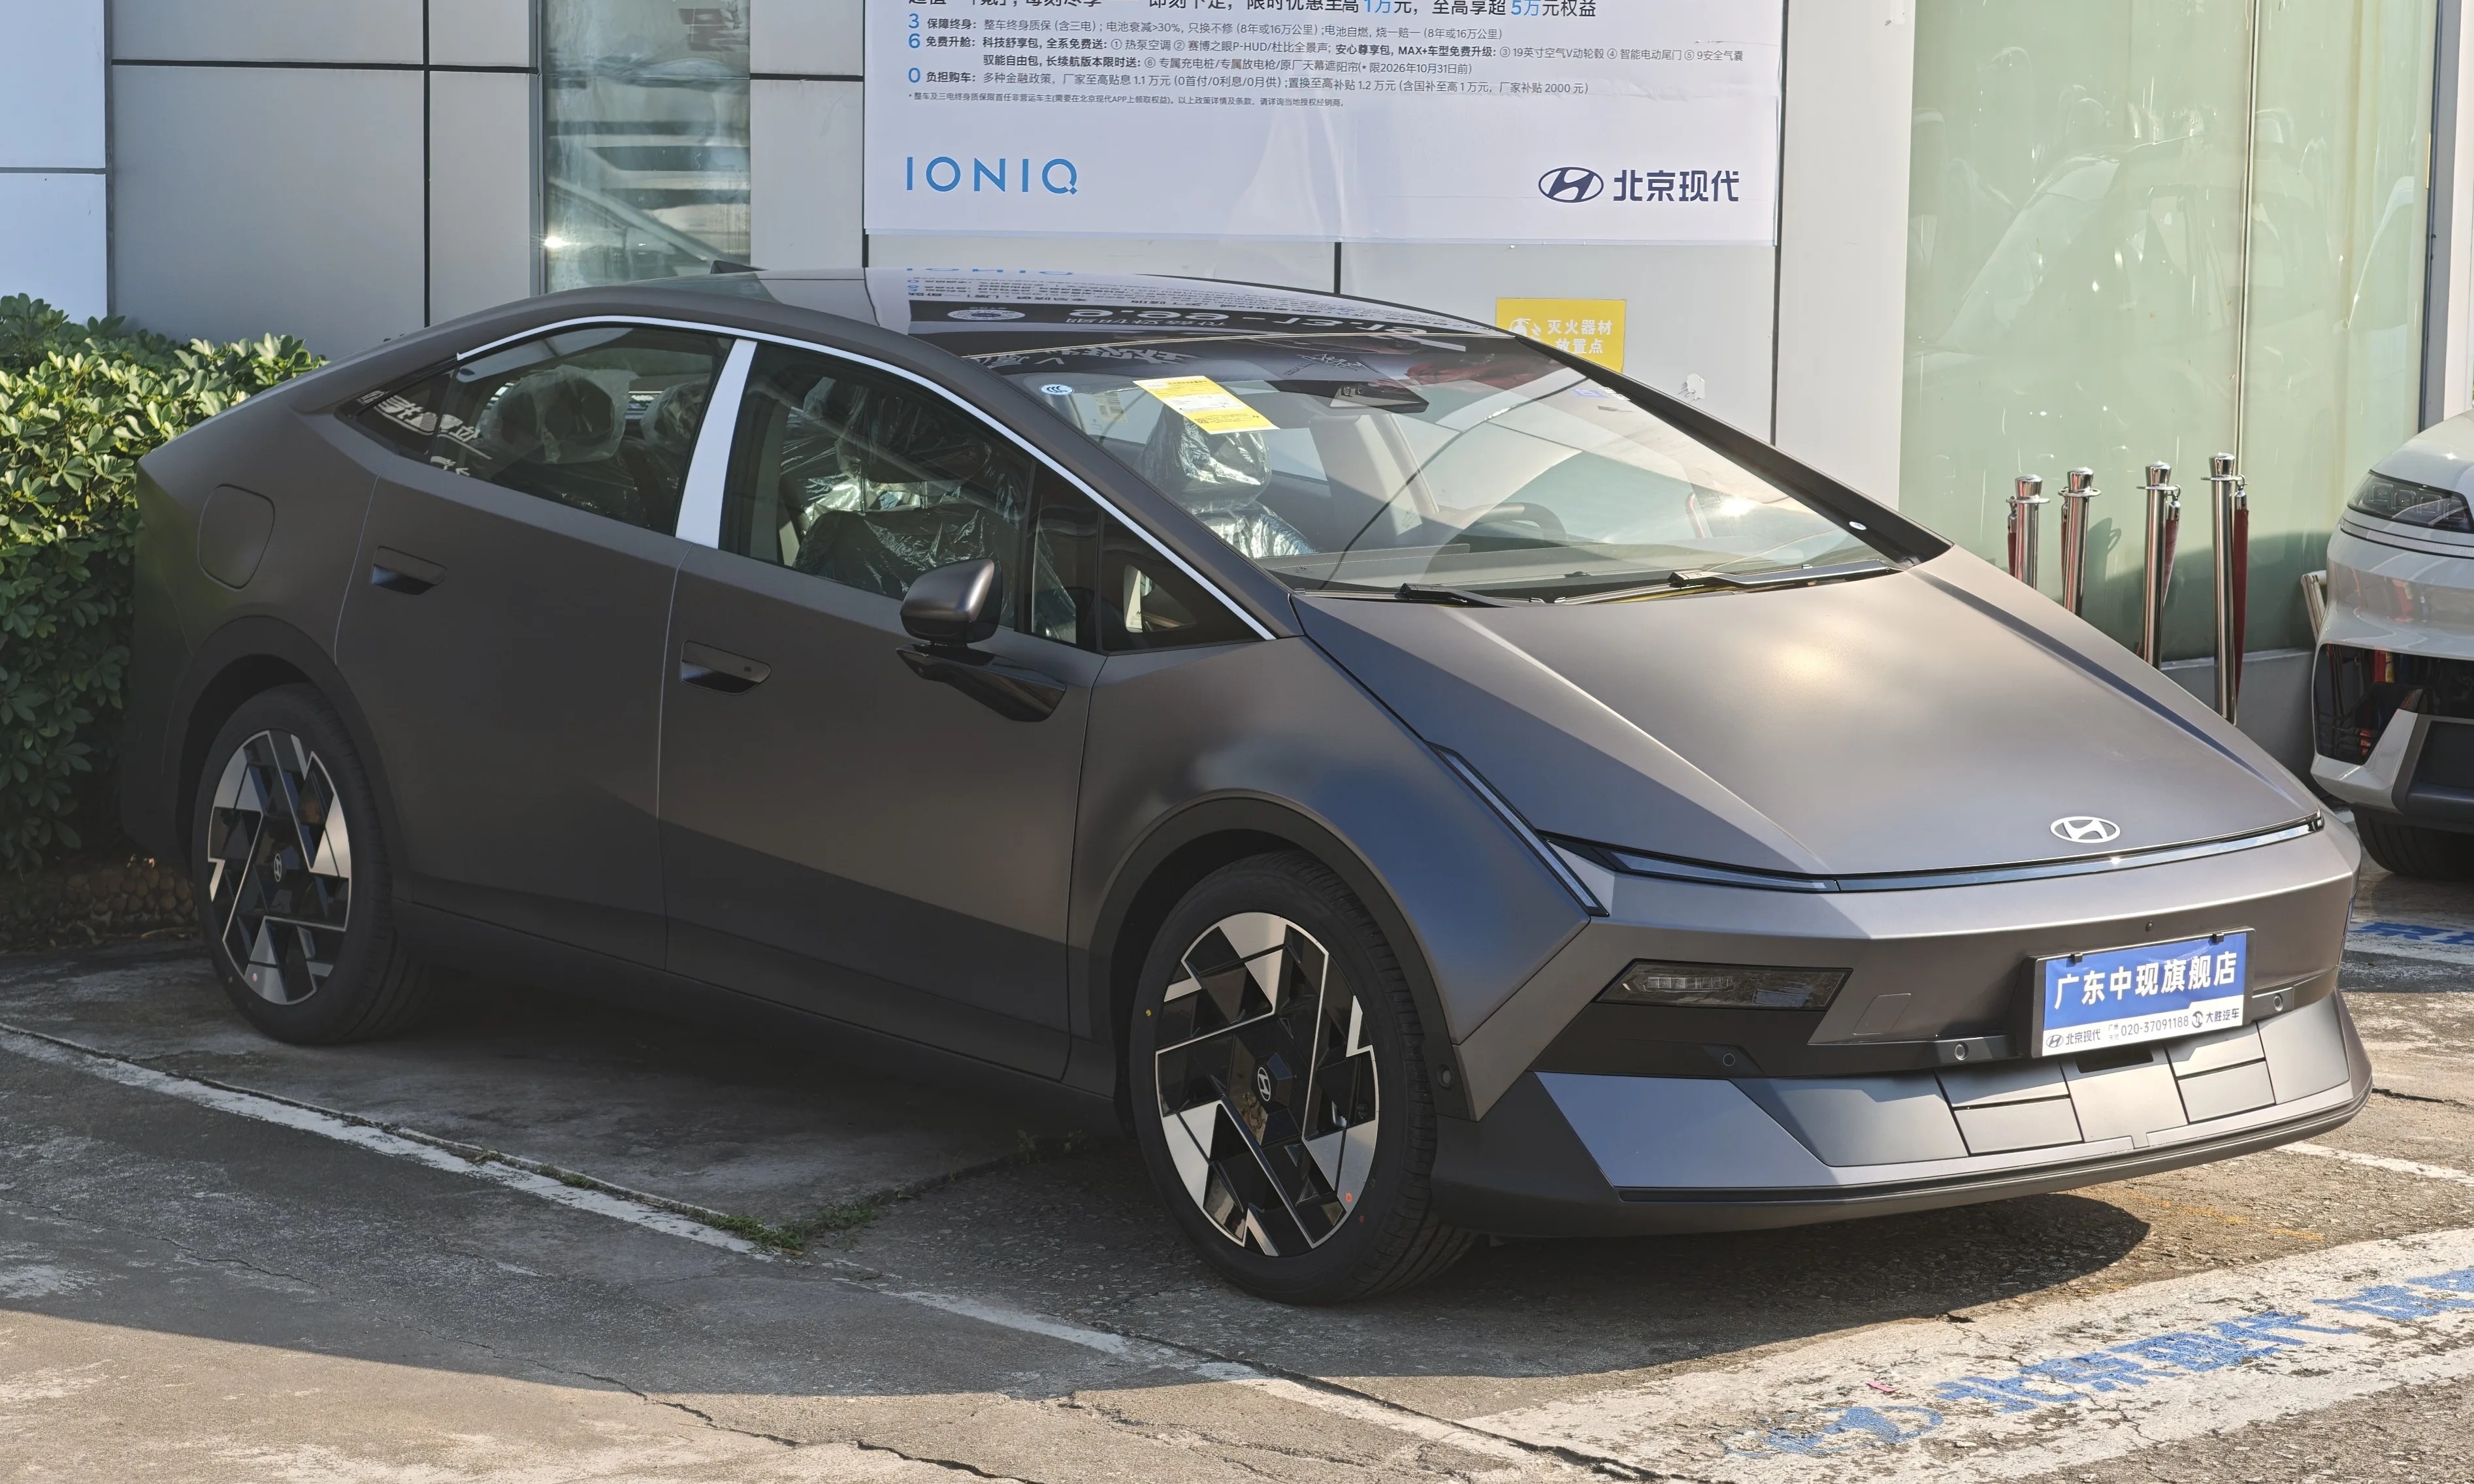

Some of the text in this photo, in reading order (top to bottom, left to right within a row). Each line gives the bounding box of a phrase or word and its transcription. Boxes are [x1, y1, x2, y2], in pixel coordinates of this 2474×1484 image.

[909, 13, 919, 29] 3
[984, 19, 1051, 31] 整车终身质保
[909, 33, 920, 48] 6
[909, 68, 920, 83] 0
[906, 156, 1077, 195] IONIQ
[1613, 170, 1739, 202] 北京现代
[1548, 319, 1612, 336] 灭火器材
[1555, 338, 1604, 354] 放置点
[2054, 951, 2237, 1010] 广东中现旗舰店
[2066, 1029, 2101, 1045] 北京现代
[2121, 1016, 2189, 1037] 020-37091188
[2206, 1008, 2239, 1024] 大胜汽车
